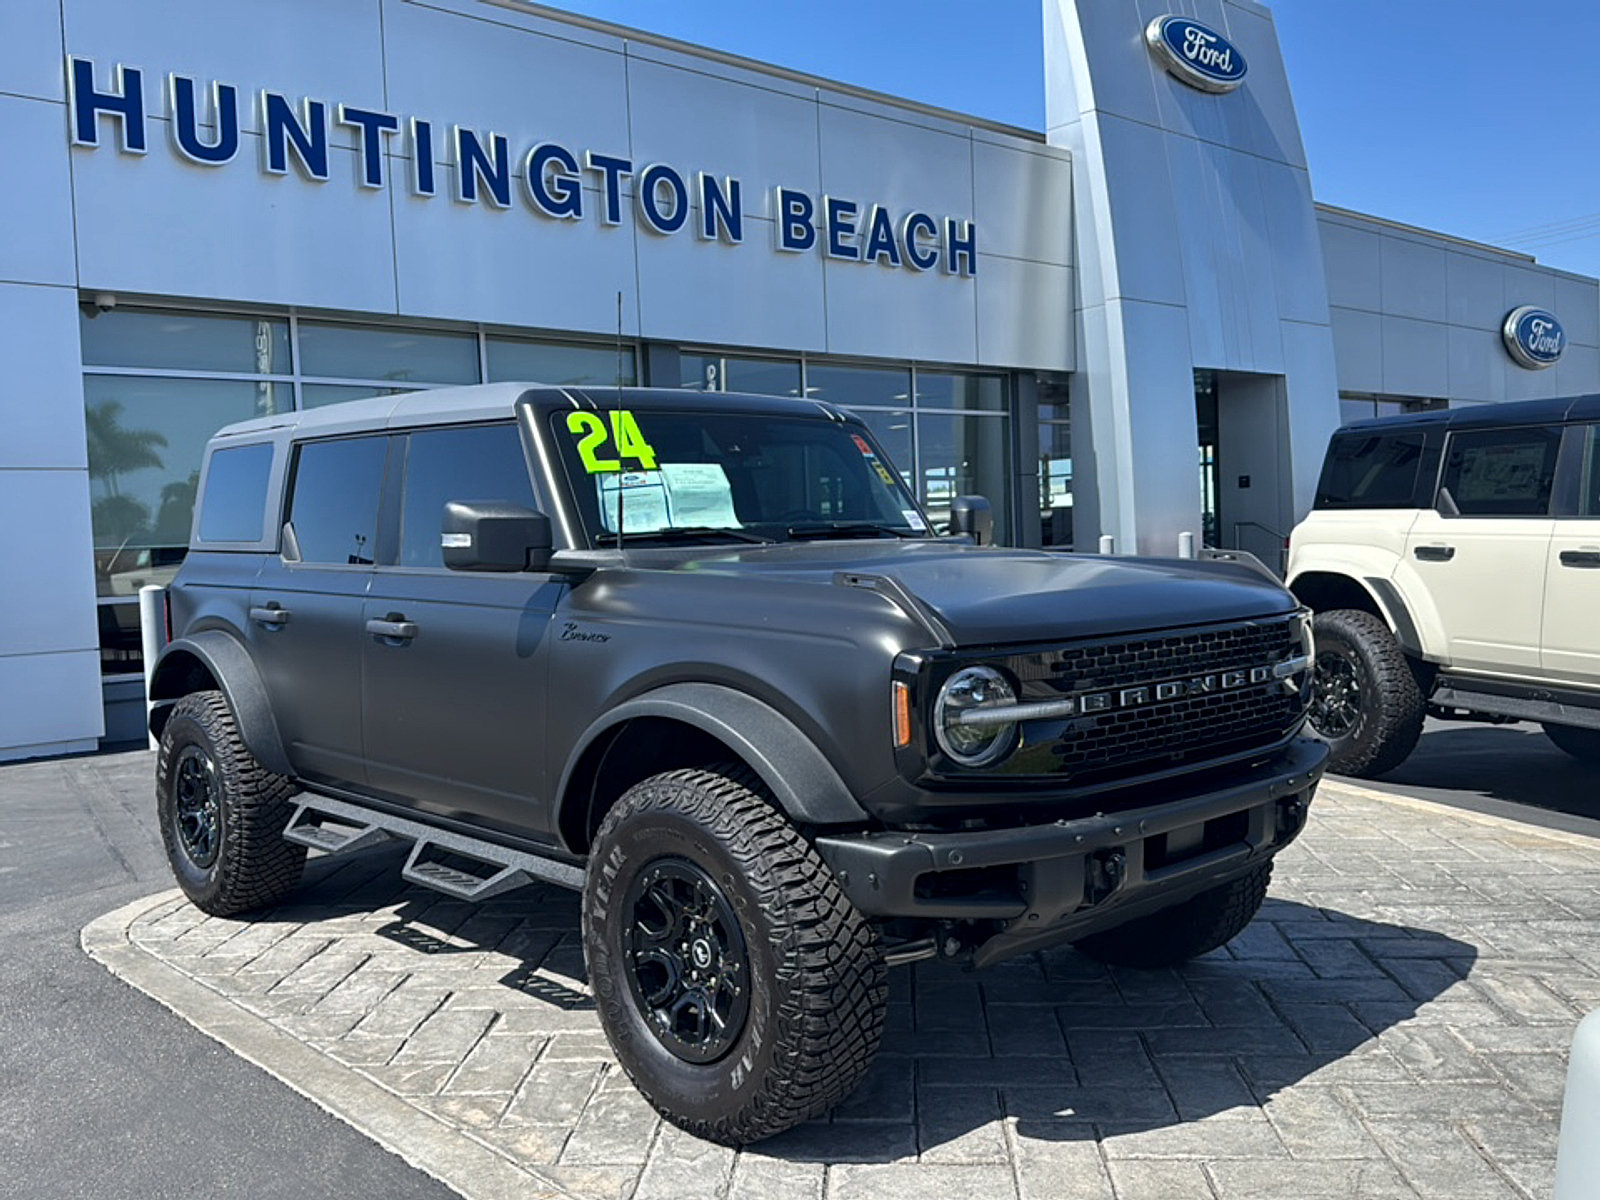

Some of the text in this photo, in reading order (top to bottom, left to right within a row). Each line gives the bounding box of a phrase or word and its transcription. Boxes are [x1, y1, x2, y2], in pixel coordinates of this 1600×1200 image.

[1183, 26, 1233, 73] Ford
[69, 56, 976, 276] HUNTINGTON BEACH
[1528, 318, 1561, 354] Ford
[566, 410, 657, 474] 24
[1080, 666, 1272, 713] BRONCO
